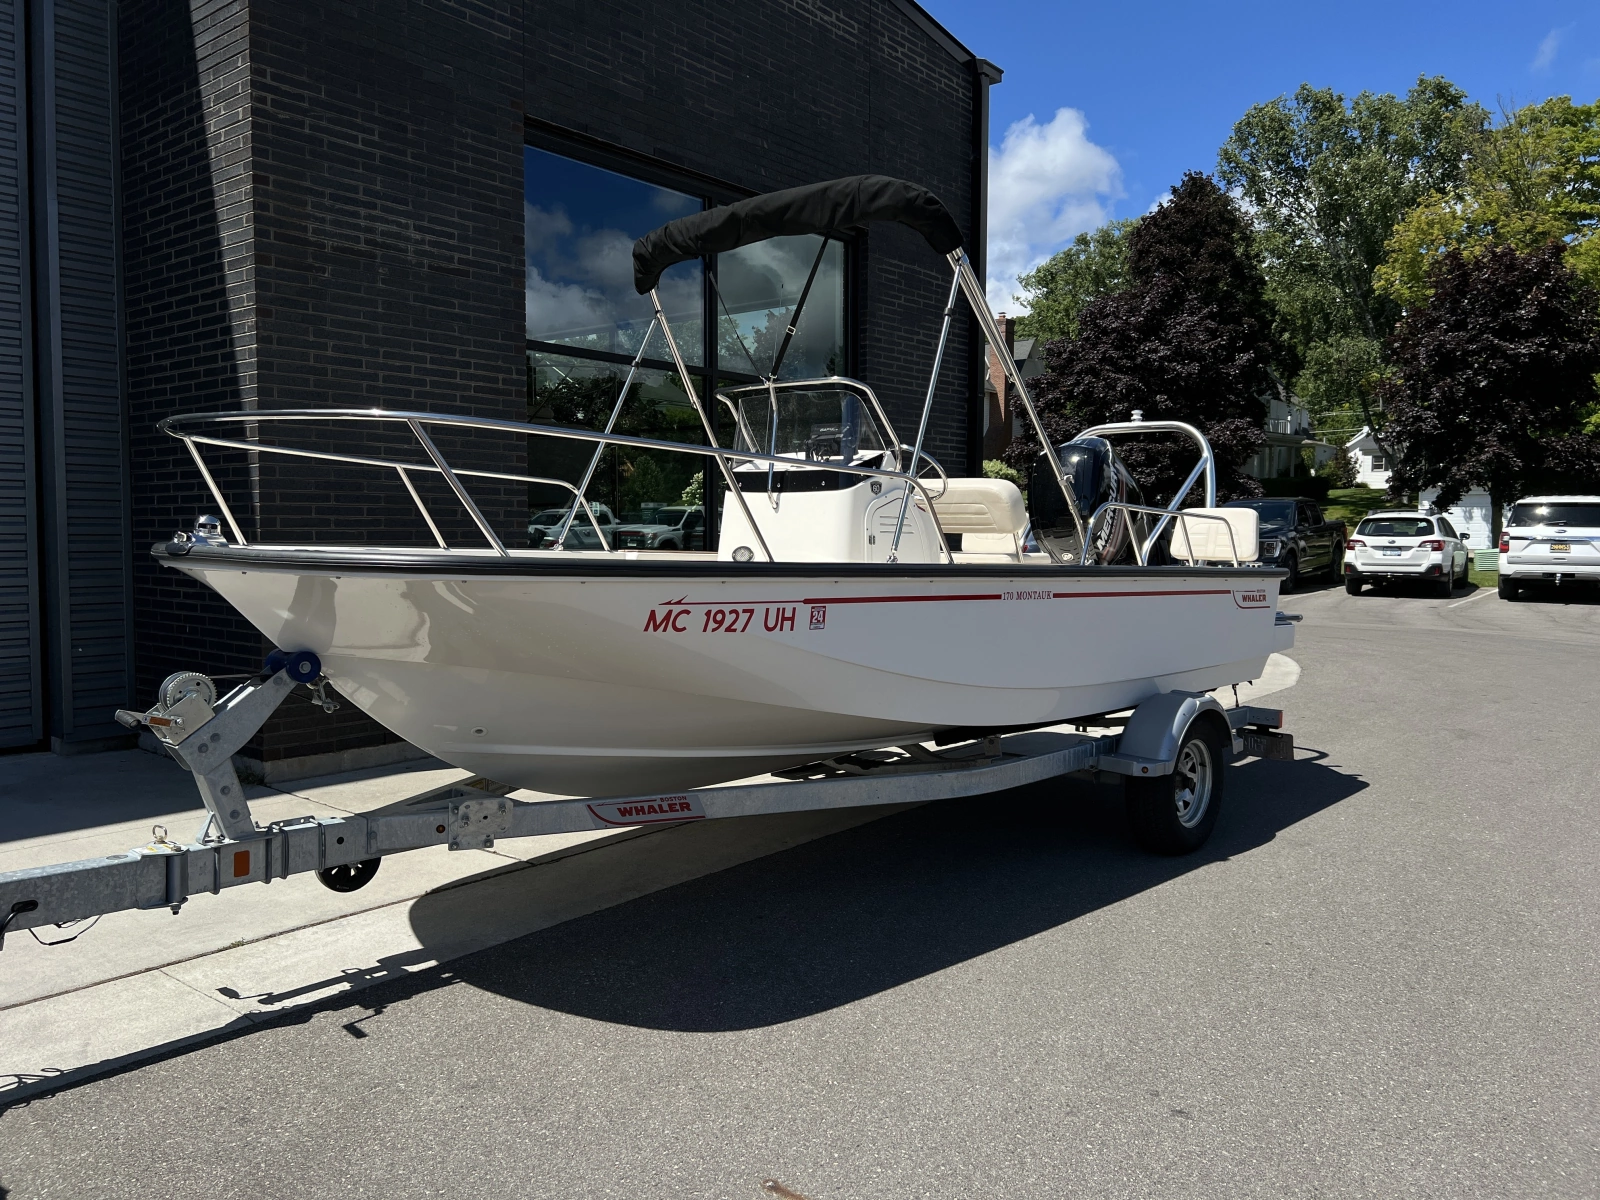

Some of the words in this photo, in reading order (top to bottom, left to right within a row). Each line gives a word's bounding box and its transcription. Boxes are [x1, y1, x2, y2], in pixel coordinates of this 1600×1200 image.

[1002, 591, 1014, 601] 170
[1015, 590, 1052, 601] MONTAUK
[1241, 594, 1267, 603] WHALER
[643, 609, 691, 633] MC
[702, 608, 755, 633] 1927
[763, 606, 797, 632] UH
[812, 610, 824, 623] 24
[659, 795, 688, 803] BOSTON
[616, 801, 693, 818] WHALER
